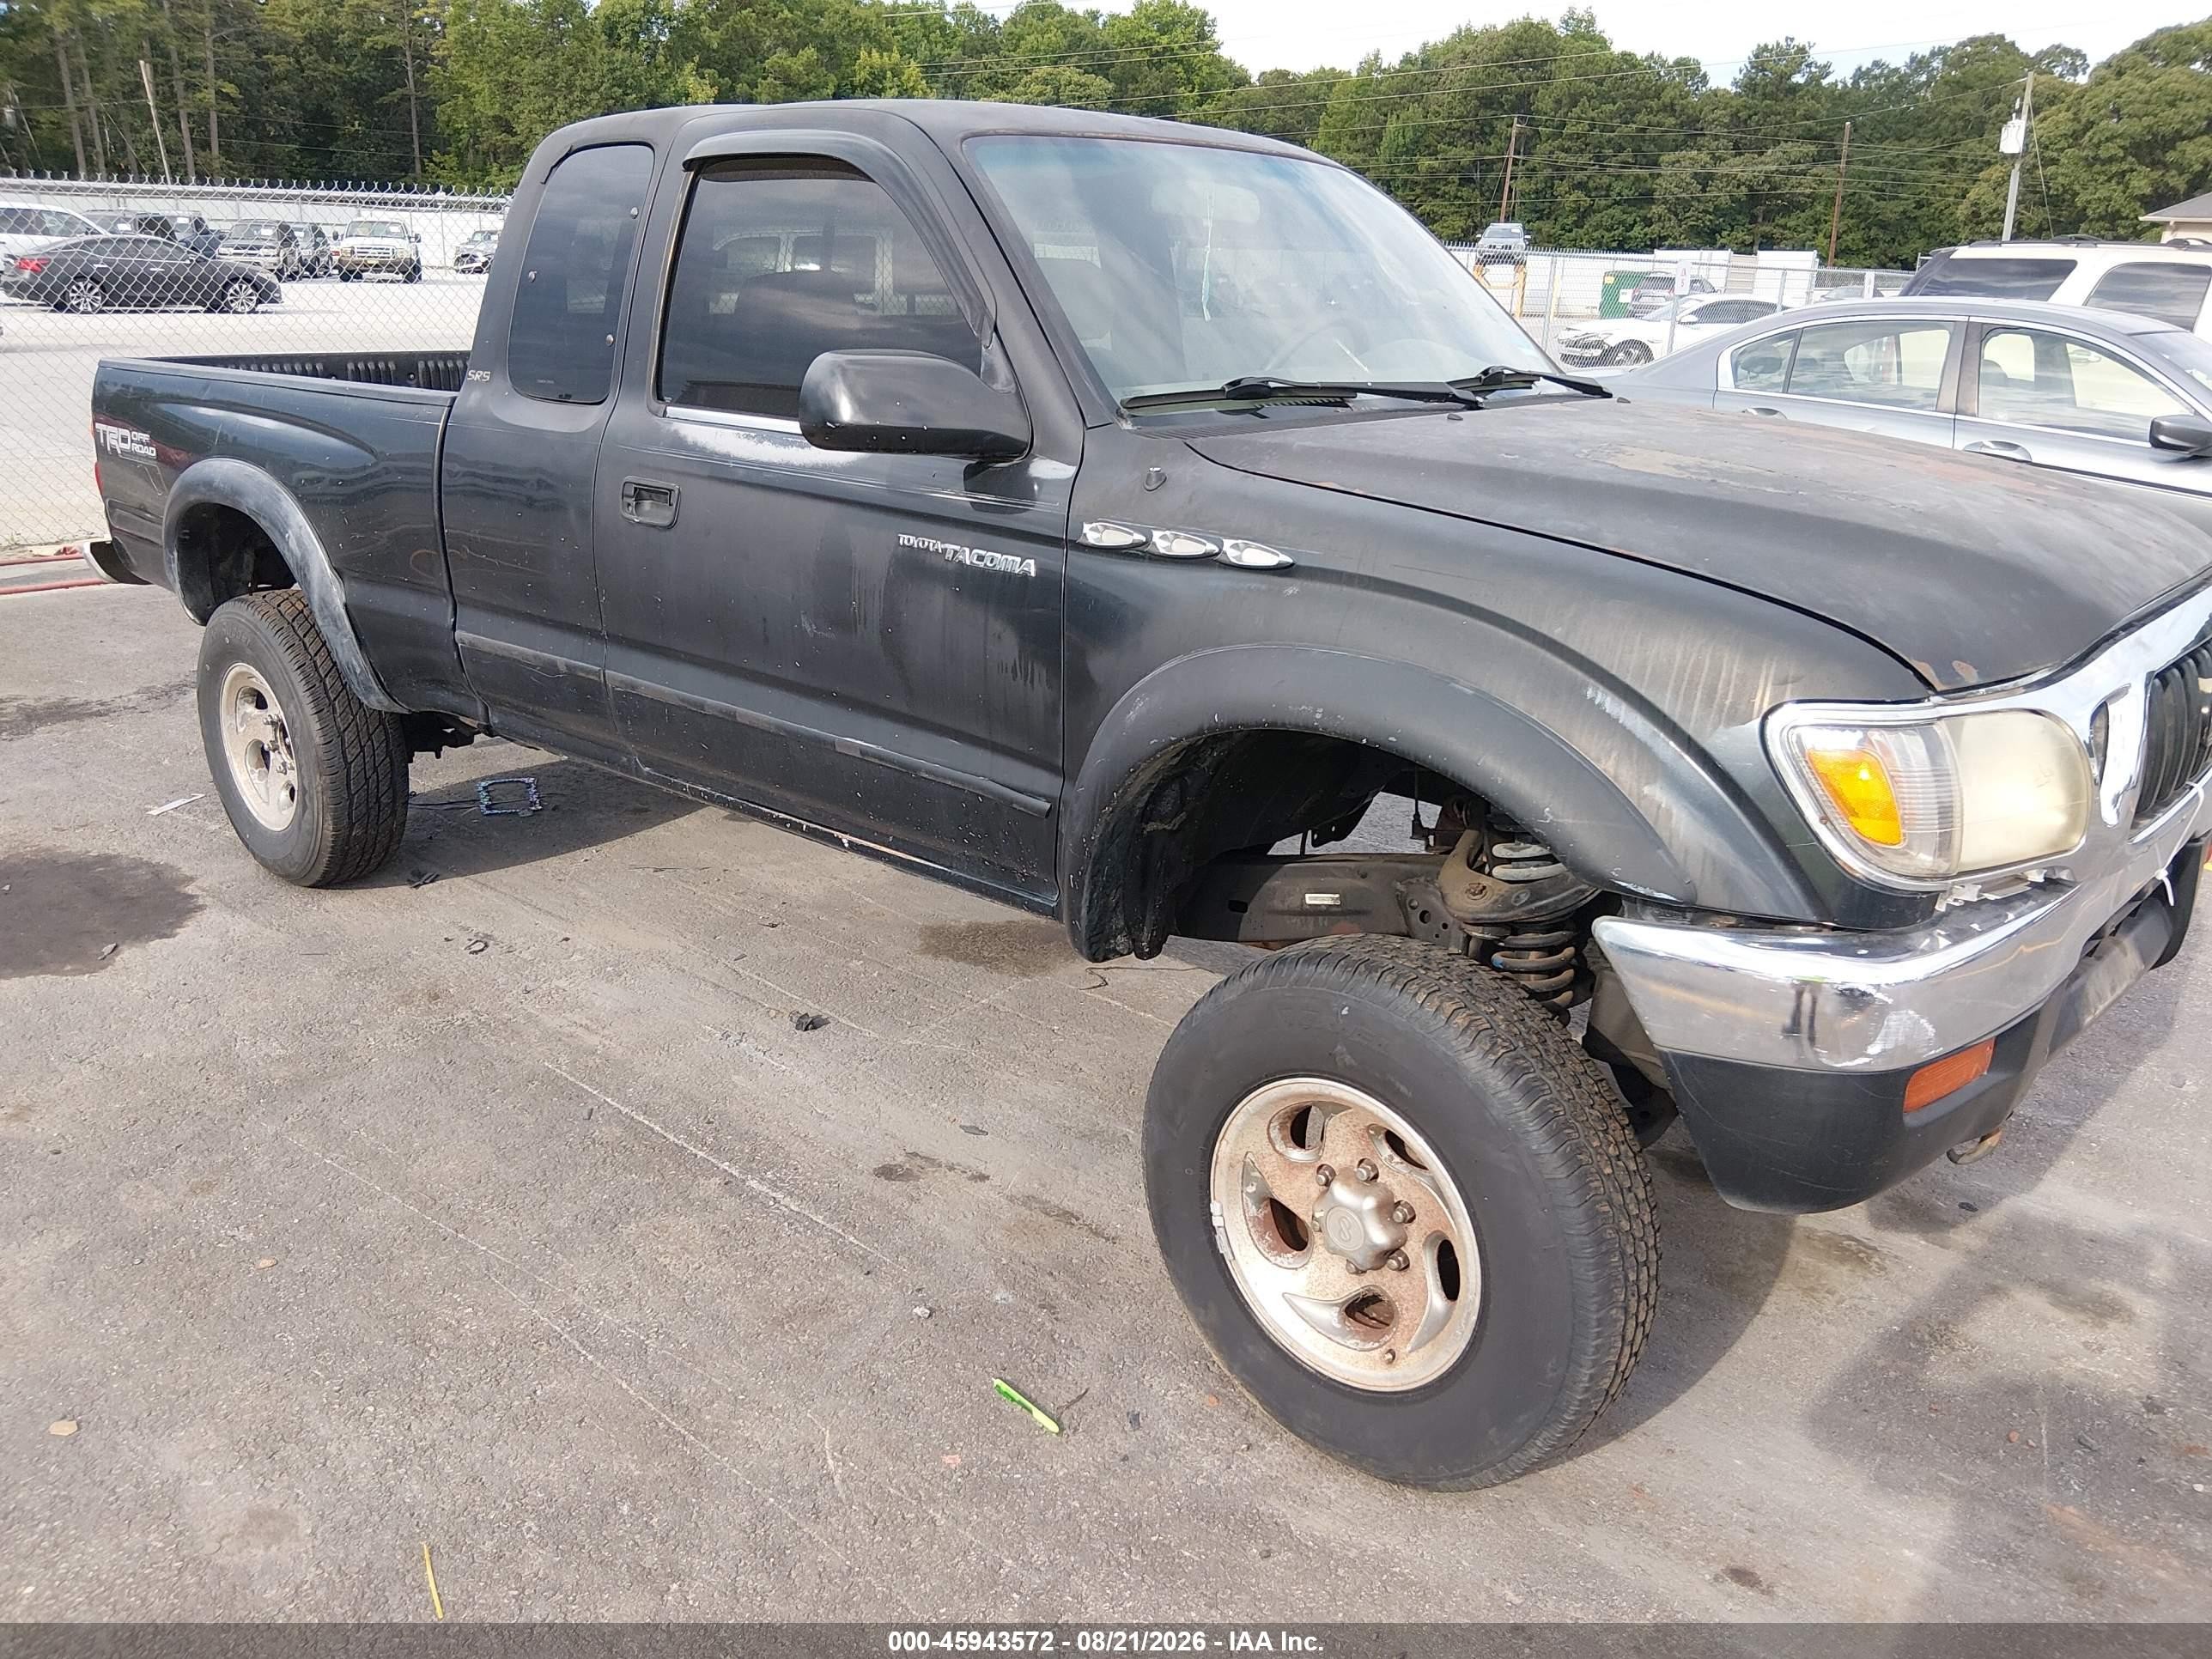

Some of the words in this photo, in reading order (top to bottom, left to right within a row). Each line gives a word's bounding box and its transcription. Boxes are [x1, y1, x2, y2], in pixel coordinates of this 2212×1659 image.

[95, 422, 131, 454] TRD
[131, 431, 150, 443] OFF
[131, 442, 156, 457] ROAD
[898, 533, 943, 553] TOYOTA
[942, 543, 1036, 577] TACOMA
